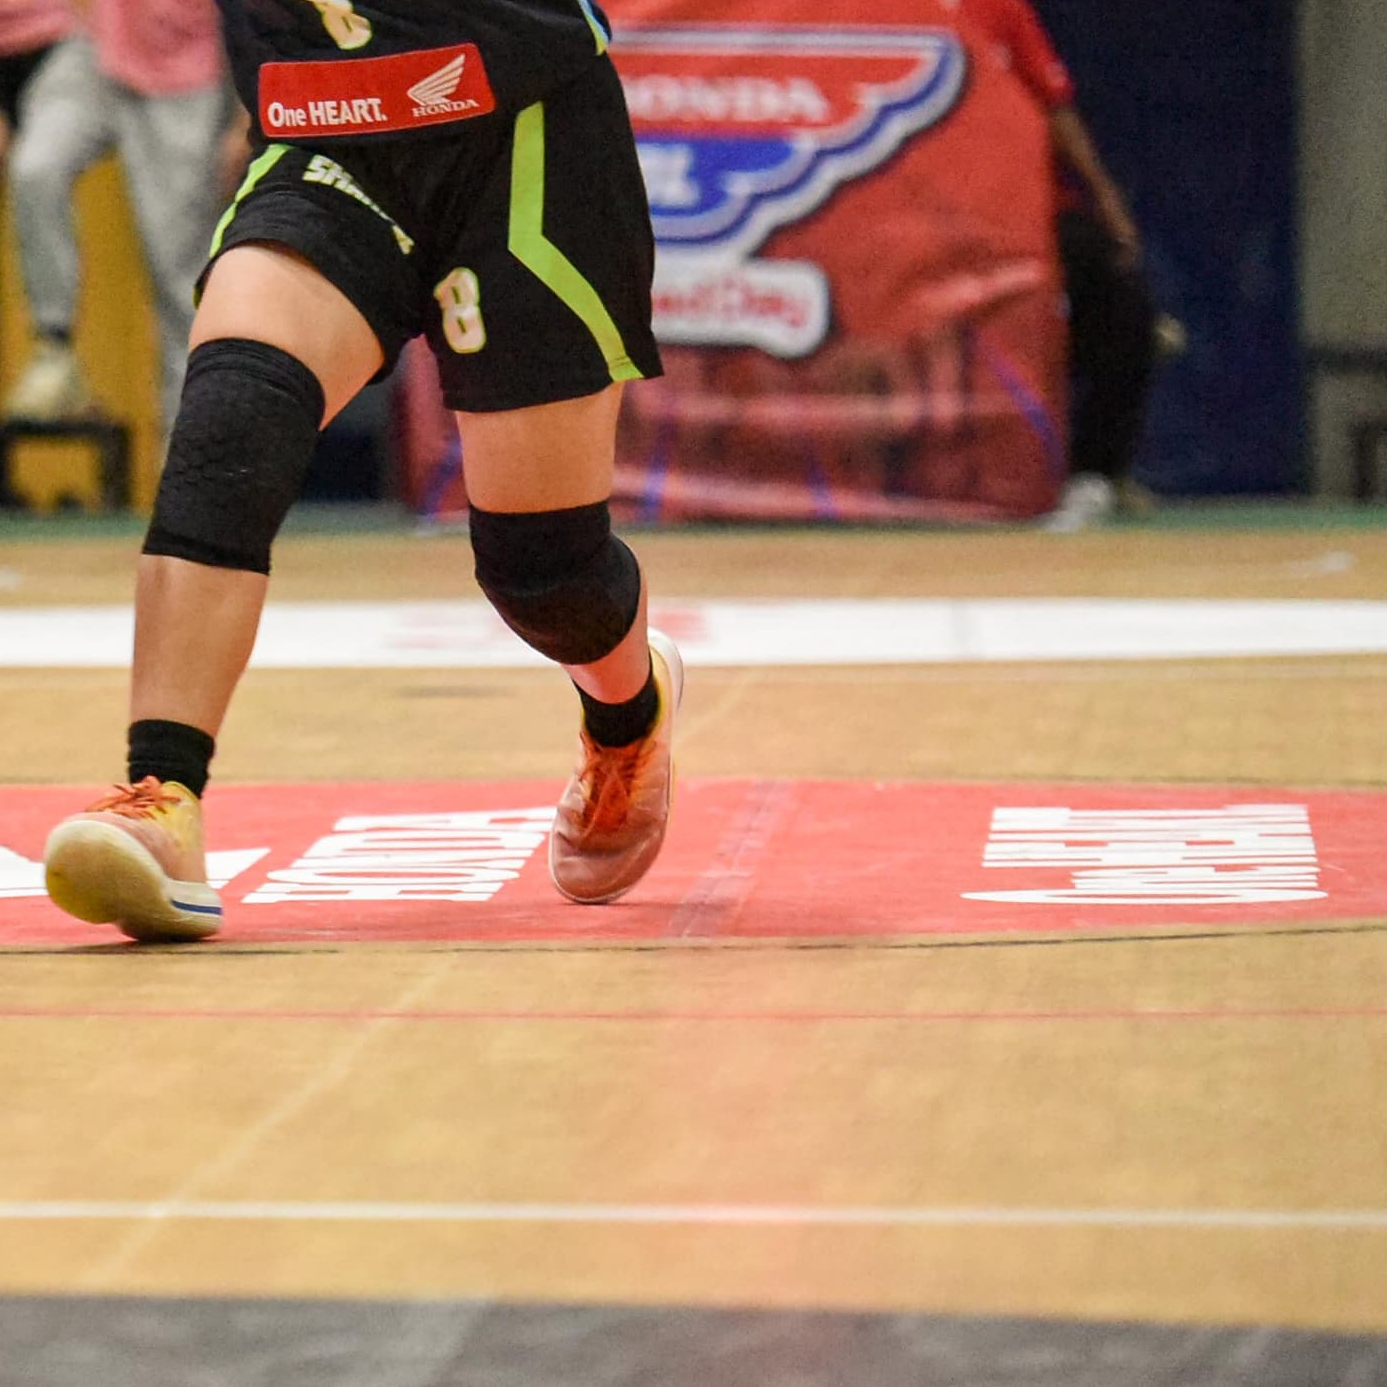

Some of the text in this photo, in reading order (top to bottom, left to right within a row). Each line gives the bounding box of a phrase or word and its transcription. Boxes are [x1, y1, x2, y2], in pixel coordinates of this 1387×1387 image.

[267, 97, 480, 128] One HEART. HONDA
[625, 75, 831, 123] ONDA
[433, 266, 487, 354] 8
